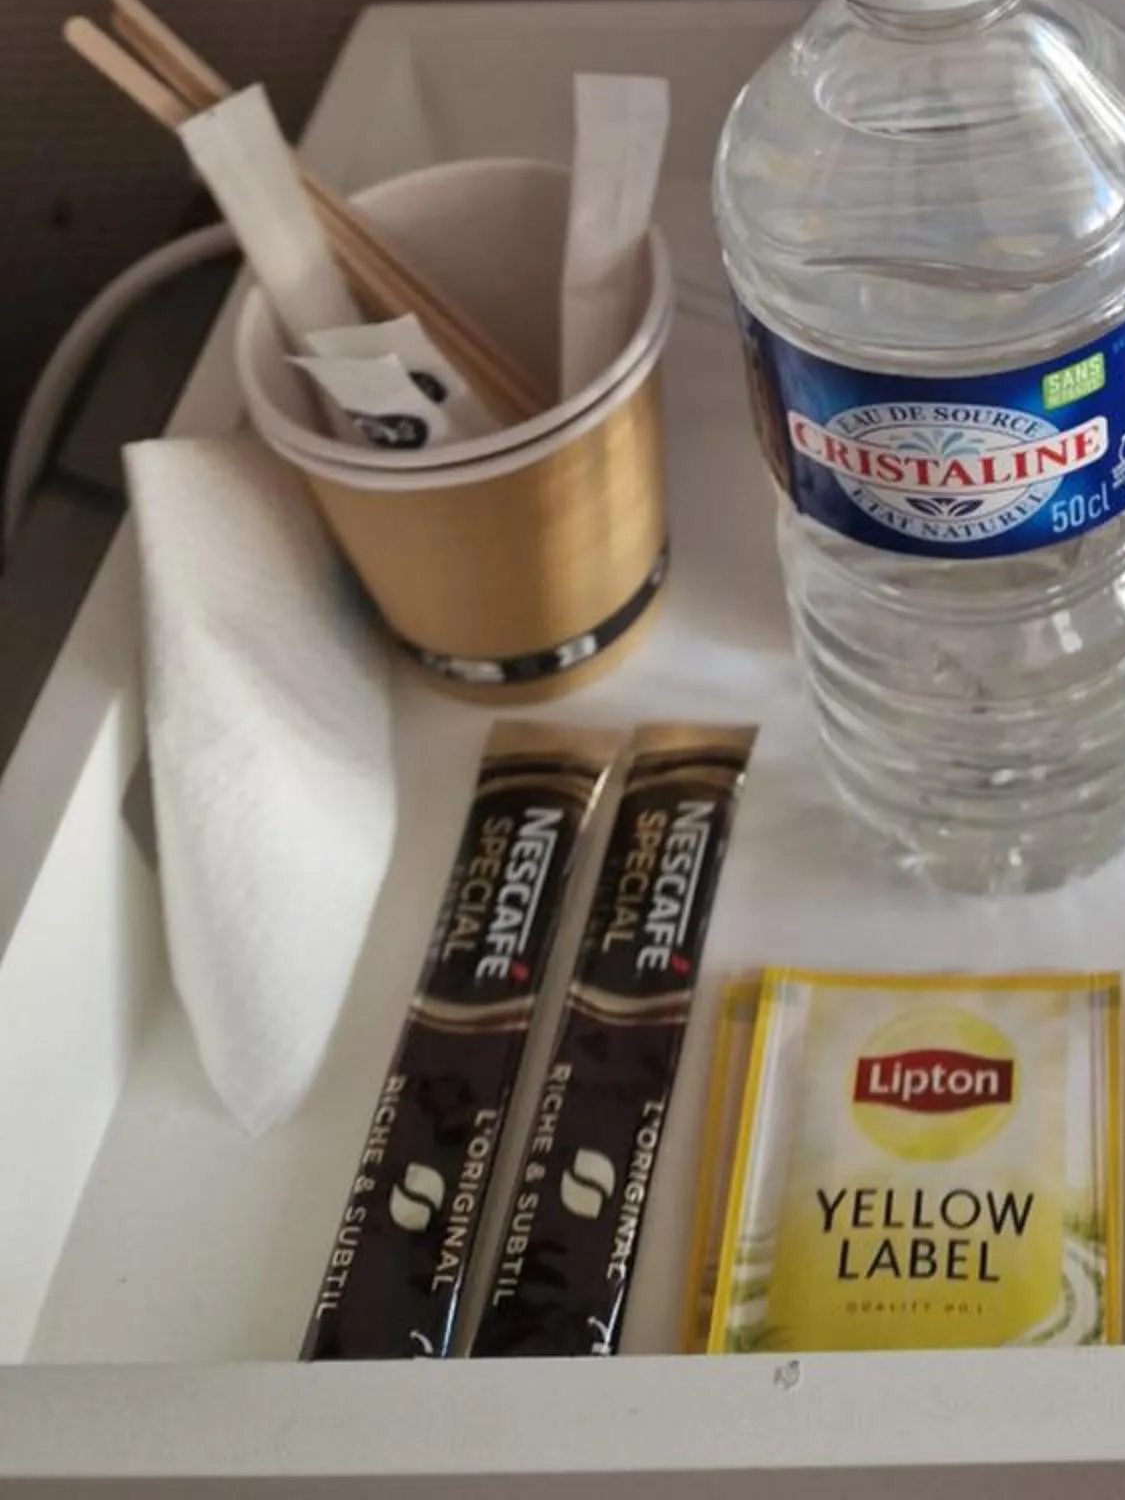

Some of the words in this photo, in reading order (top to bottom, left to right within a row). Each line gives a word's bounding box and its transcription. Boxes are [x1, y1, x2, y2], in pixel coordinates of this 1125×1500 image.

[1048, 356, 1102, 396] SANS
[837, 408, 884, 434] EAU
[889, 405, 928, 422] DE
[932, 406, 1046, 438] SOURCE
[794, 420, 1100, 486] CRISTALINE
[1052, 484, 1110, 533] 50cl
[442, 815, 514, 963] SPECIAL
[602, 810, 669, 954] SPECIAL
[532, 1063, 573, 1152] RICHE
[868, 1061, 999, 1102] Lipton
[362, 1074, 408, 1166] RICHE
[354, 1174, 377, 1196] &
[431, 1108, 498, 1292] L'ORIGINAL
[525, 1162, 547, 1183] &
[816, 1187, 1034, 1236] YELLOW
[316, 1205, 368, 1321] SUBTIL
[492, 1193, 540, 1307] SUBTIL
[836, 1237, 1000, 1283] LABEL
